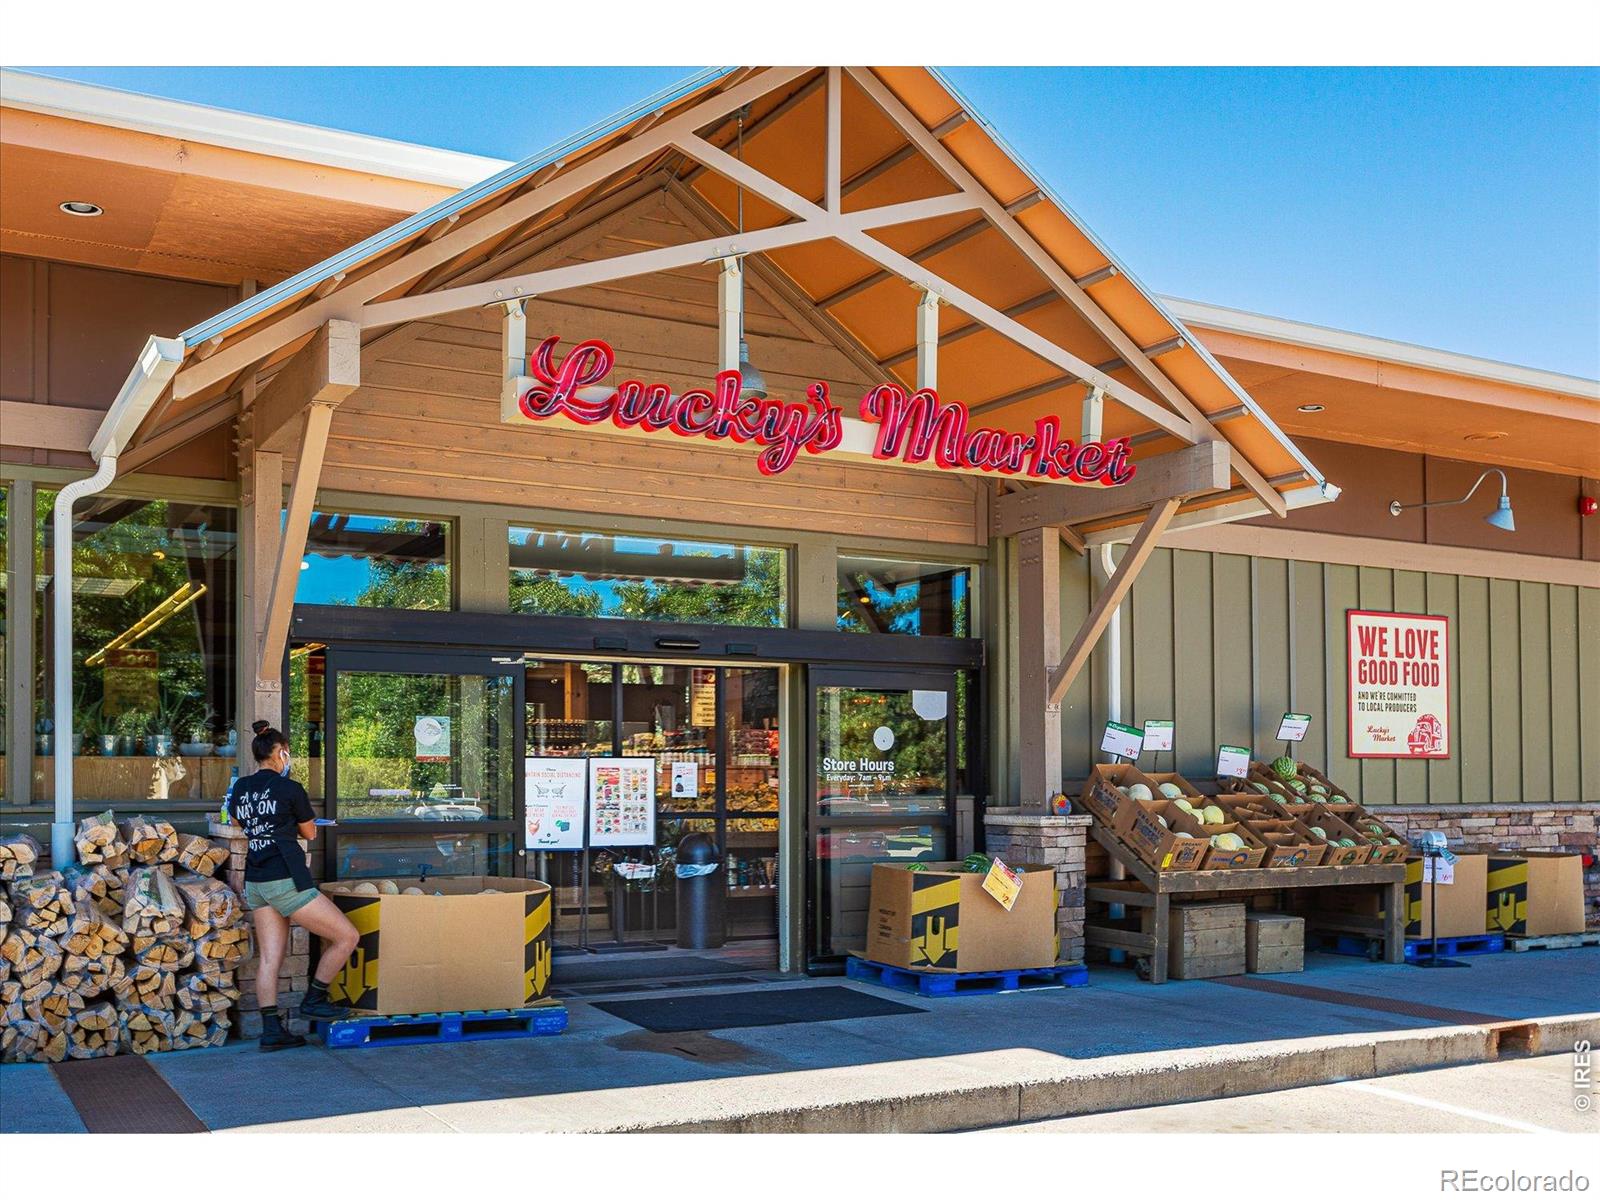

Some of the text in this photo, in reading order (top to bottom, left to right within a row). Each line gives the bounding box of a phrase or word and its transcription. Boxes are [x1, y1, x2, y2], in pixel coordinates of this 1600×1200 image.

[518, 335, 1136, 486] Lucky's Market
[1357, 626, 1439, 660] WE LOVE
[1358, 659, 1440, 687] GOOD FOOD
[1358, 691, 1417, 702] AND WE'RE COMMITTED
[1358, 702, 1417, 713] TO LOCAL PRODUCERS
[1372, 734, 1396, 742] Market
[823, 757, 895, 771] Store Hours
[826, 774, 856, 783] Everyday:
